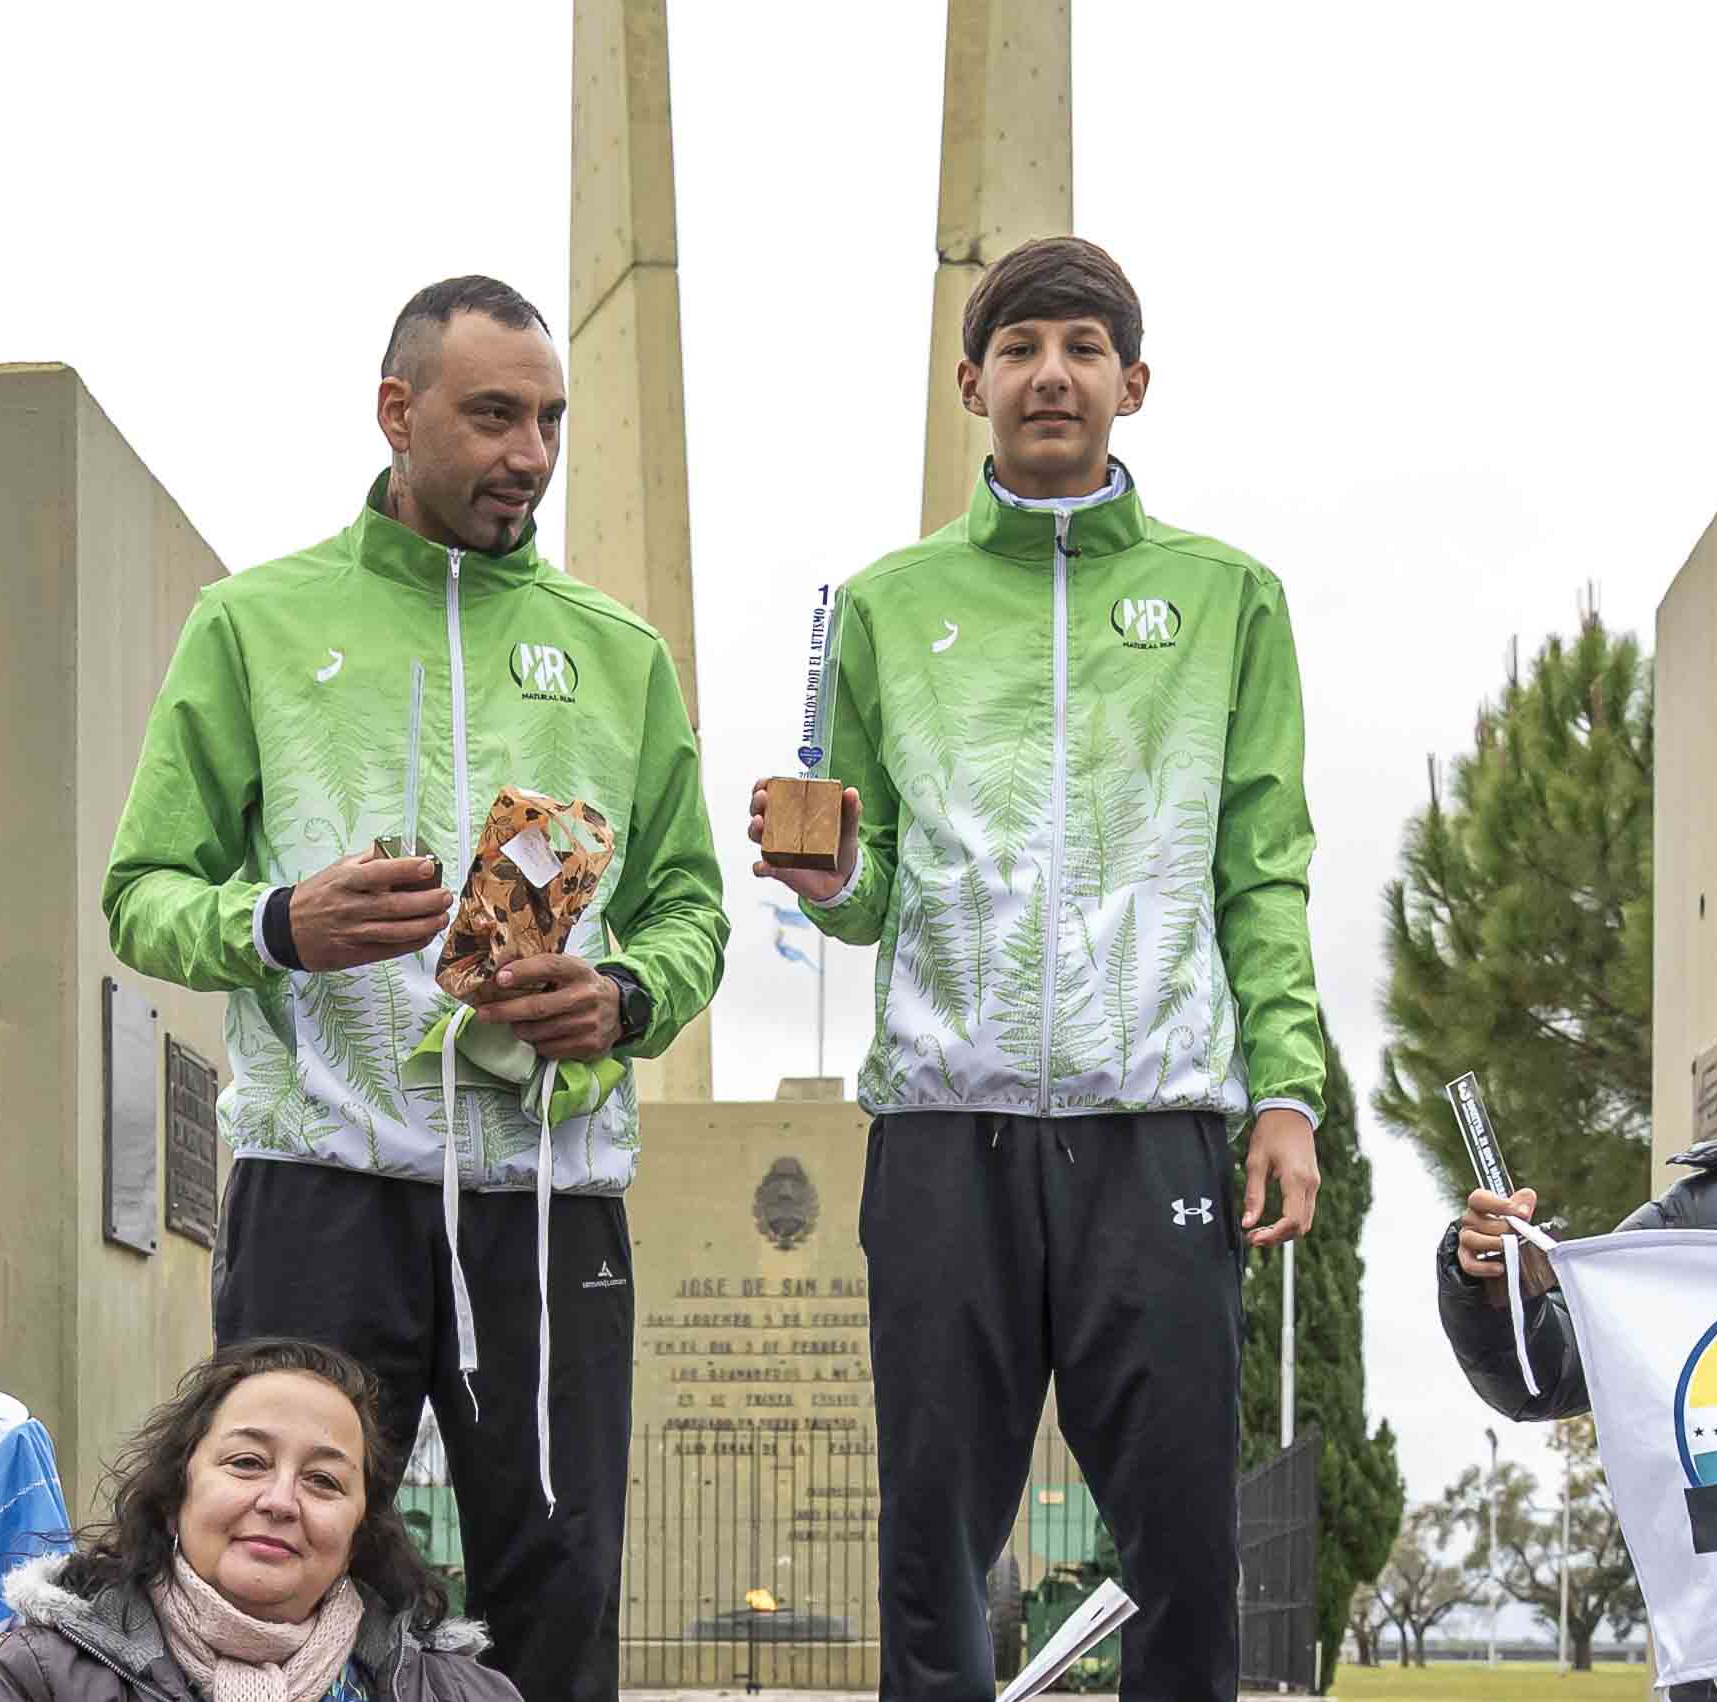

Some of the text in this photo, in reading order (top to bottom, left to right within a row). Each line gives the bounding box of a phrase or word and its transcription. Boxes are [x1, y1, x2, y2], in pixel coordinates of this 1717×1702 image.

[818, 585, 829, 605] 1
[811, 608, 826, 651] AUTISMO
[810, 656, 822, 669] EL
[807, 671, 820, 696] POR
[679, 1279, 728, 1296] JOSE
[742, 1279, 764, 1296] DE
[811, 1314, 870, 1326] FEBRER
